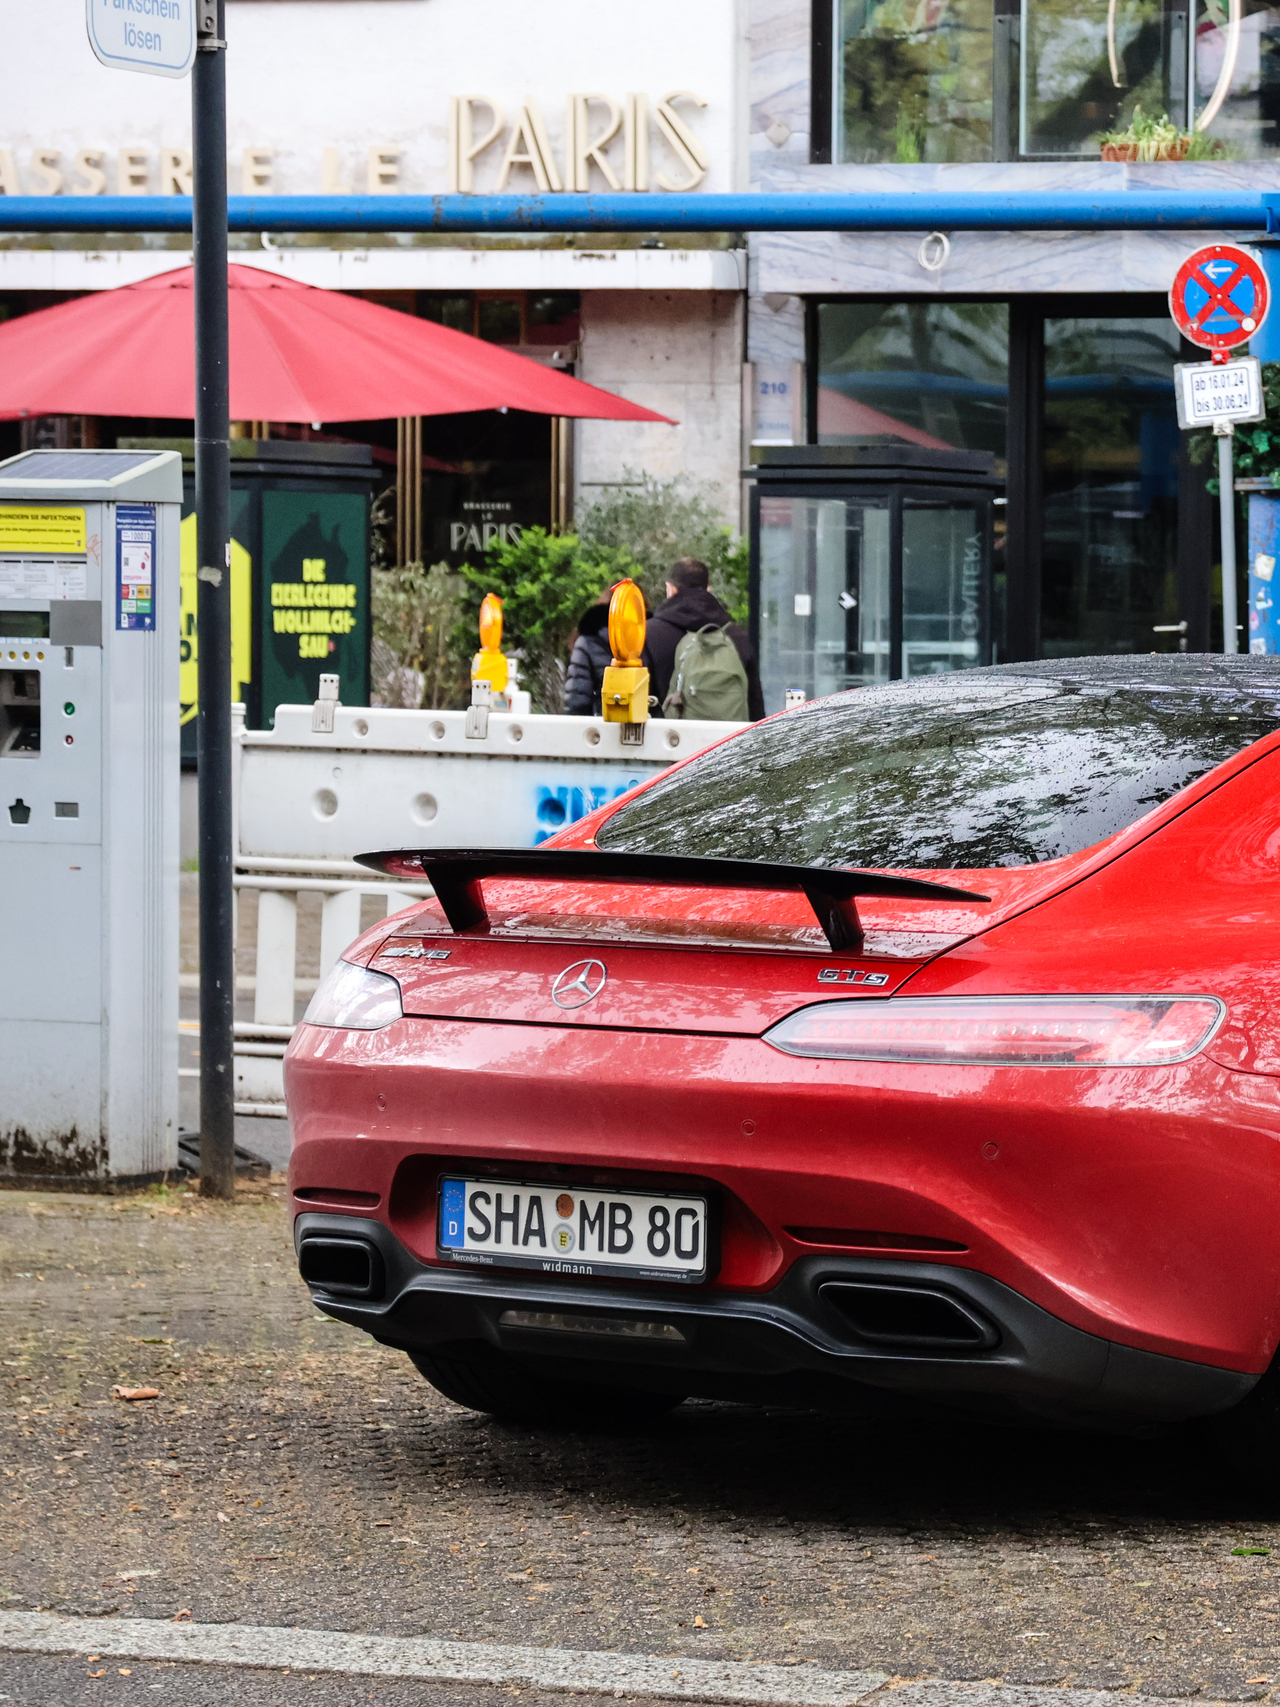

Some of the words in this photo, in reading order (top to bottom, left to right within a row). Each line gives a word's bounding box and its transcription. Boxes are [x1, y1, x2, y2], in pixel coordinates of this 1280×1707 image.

[124, 22, 162, 51] lösen
[448, 92, 711, 191] PARIS
[322, 147, 401, 194] LE
[760, 382, 787, 394] 210
[1195, 376, 1206, 391] ab
[1209, 372, 1244, 389] 16.01.24
[1197, 398, 1210, 412] bis
[1212, 394, 1248, 411] 30.06.24
[303, 558, 326, 582] DIE
[449, 1221, 458, 1237] D
[467, 1190, 547, 1248] SHA
[578, 1199, 634, 1254] MB
[647, 1205, 700, 1260] 80
[452, 1252, 494, 1264] Mercedes-Benz
[542, 1261, 593, 1275] widmann
